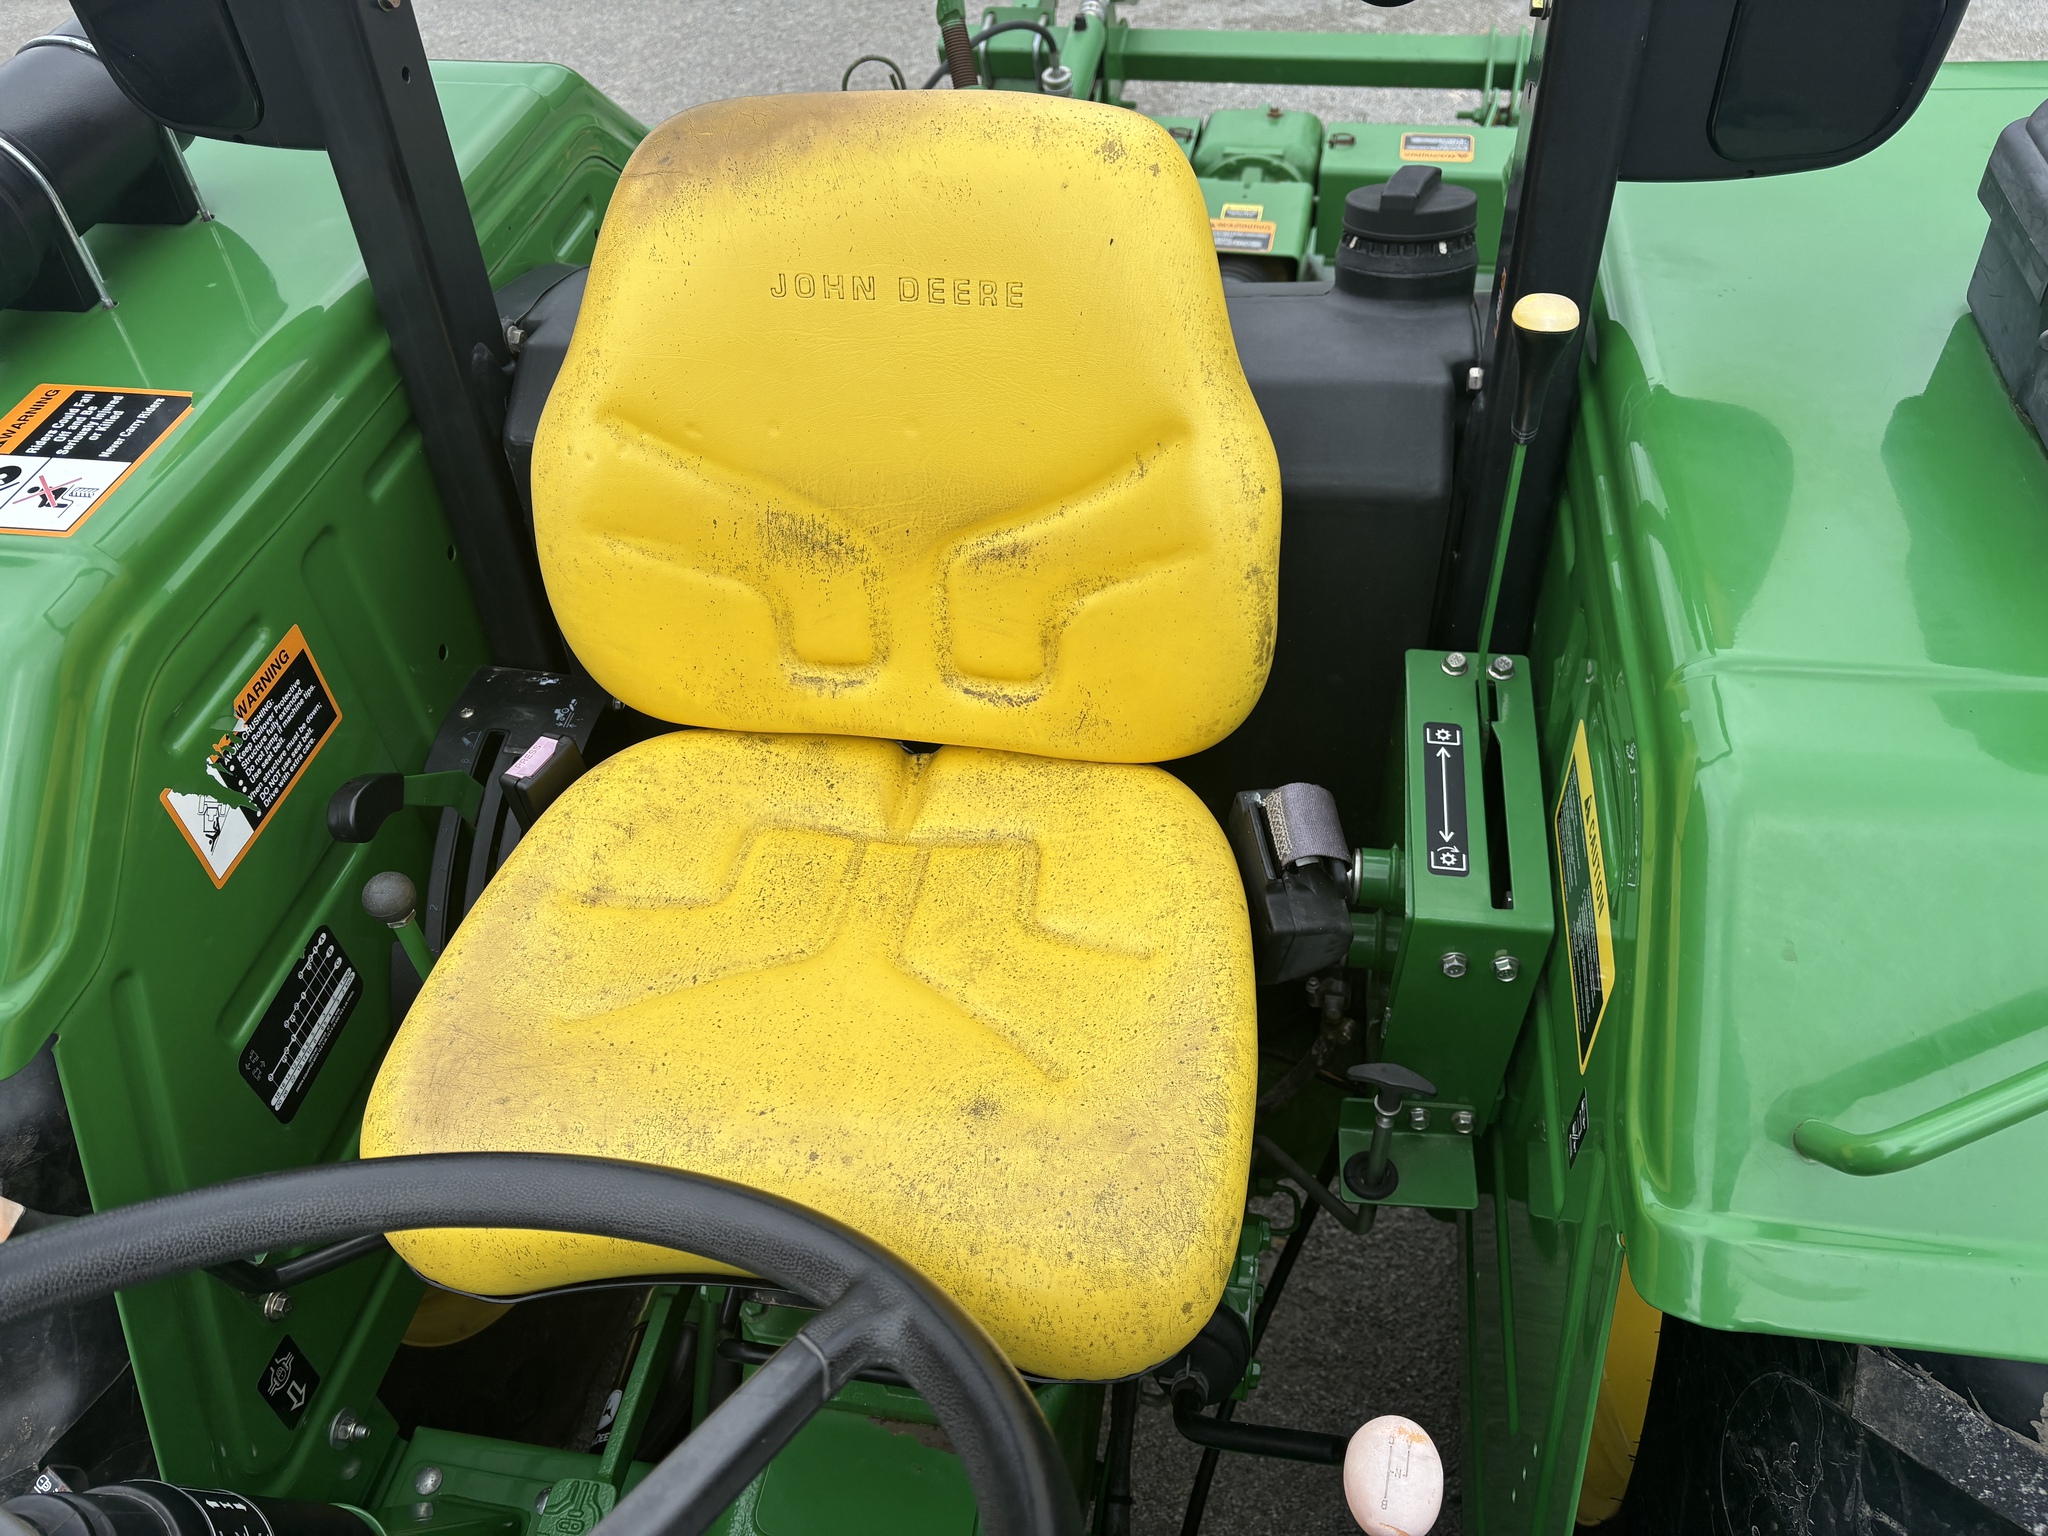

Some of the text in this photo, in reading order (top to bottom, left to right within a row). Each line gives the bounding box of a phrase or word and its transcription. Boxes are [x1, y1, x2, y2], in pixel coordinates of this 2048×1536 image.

[770, 272, 1024, 309] JOHN DEERE
[3, 389, 61, 438] WARNING
[24, 393, 96, 454] Riders Could Fall
[52, 405, 98, 442] Off and Be
[55, 395, 124, 455] Seriously Injured
[88, 410, 125, 441] or Killed
[97, 397, 165, 458] Never Carry Riders
[234, 648, 290, 719] WARNING
[236, 678, 301, 765] Keep Rollover Protective
[240, 686, 304, 770] Structure fully extended.
[241, 698, 275, 741] CRUSHING:
[244, 684, 316, 777] Do not jump if machine tips.
[262, 749, 287, 783] structure
[285, 730, 300, 751] must
[297, 722, 307, 733] be
[305, 701, 322, 724] down;
[248, 736, 286, 784] Use seat belt.
[258, 726, 314, 801] DO NOT use seat belt.
[262, 737, 316, 808] Drive with extra care.
[514, 743, 542, 770] PRESS
[1588, 824, 1605, 918] CAUTION
